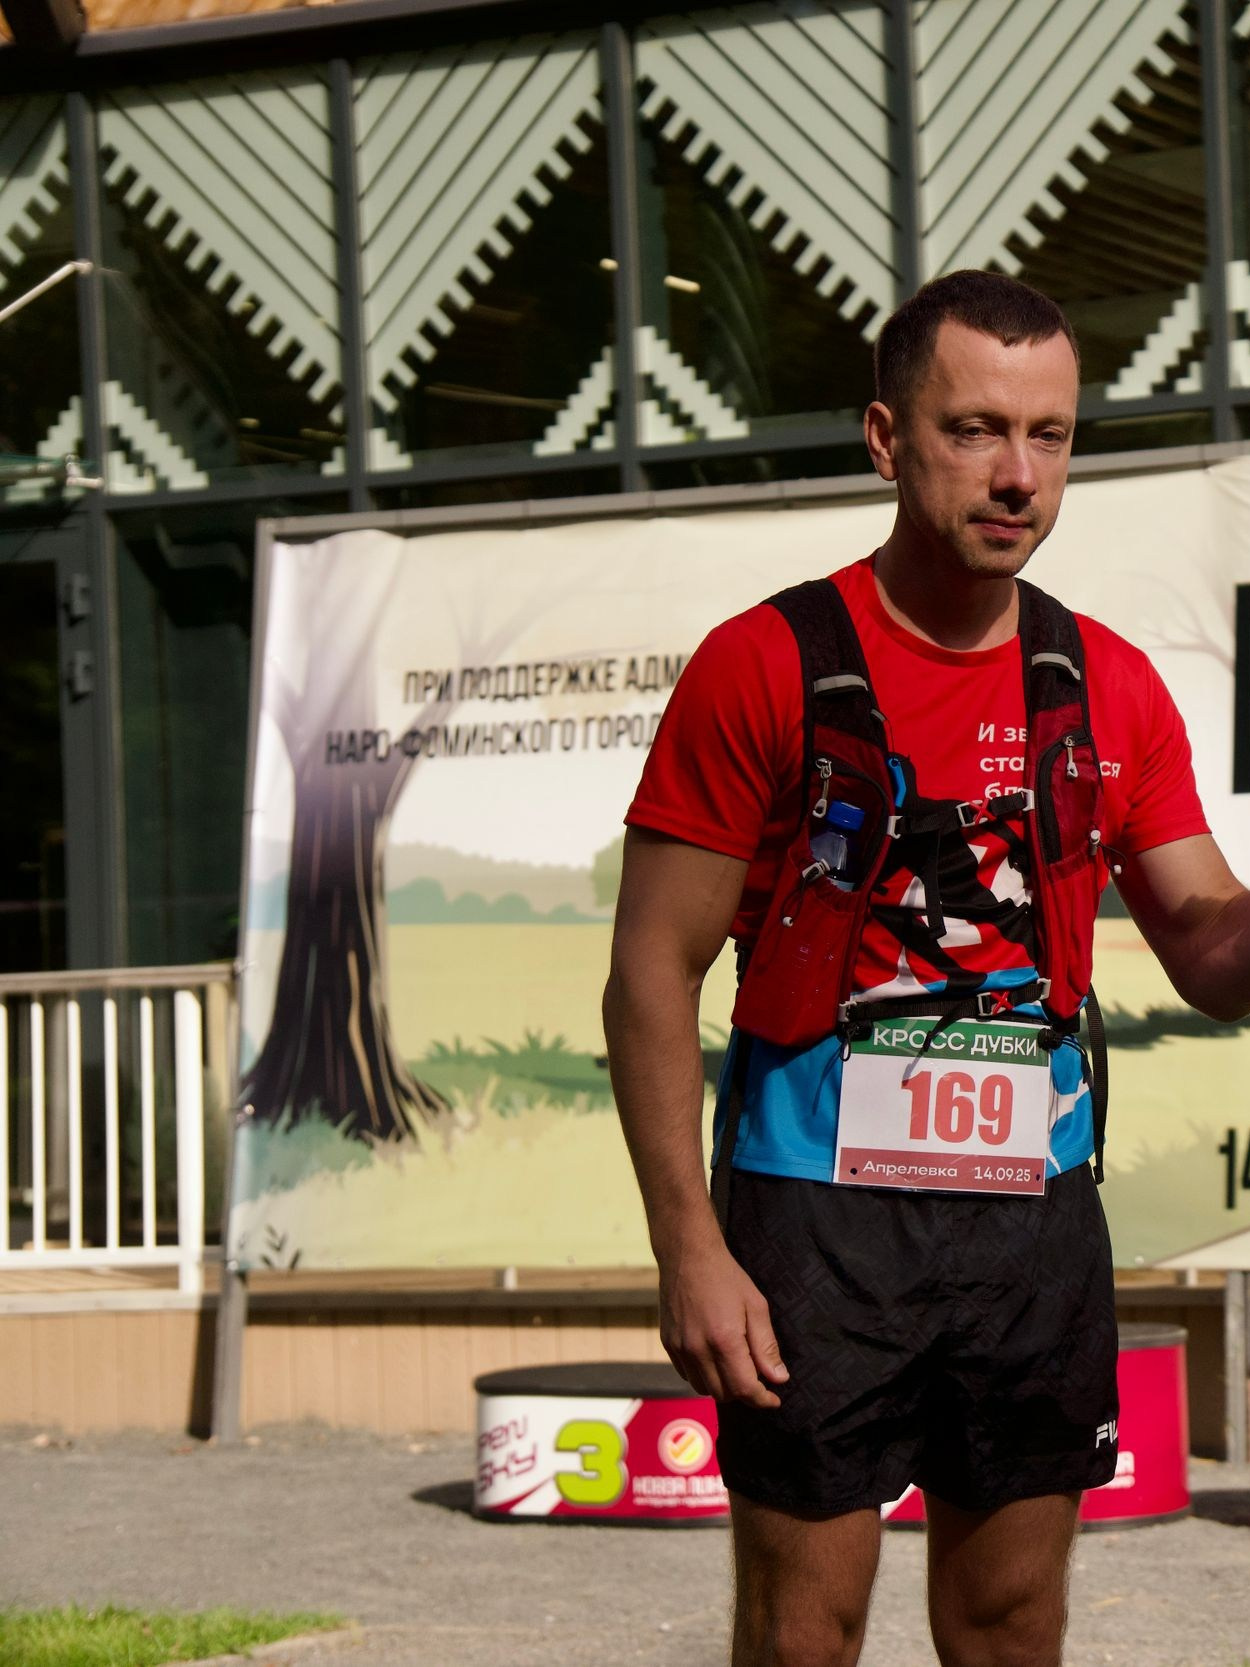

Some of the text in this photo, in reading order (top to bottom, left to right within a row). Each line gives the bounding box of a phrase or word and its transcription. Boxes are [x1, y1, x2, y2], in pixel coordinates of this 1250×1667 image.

[403, 671, 455, 704] ПРИ
[460, 658, 617, 702] ПОДДЕРЖКЕ
[325, 716, 578, 765] НАРО-ФОМИНСКОГО
[977, 722, 995, 743] И
[874, 1028, 1037, 1057] КРОСС ДУБКИ
[901, 1070, 1014, 1146] 169
[862, 1160, 1031, 1182] Апрелевка 14.09.25
[554, 1419, 629, 1507] 3
